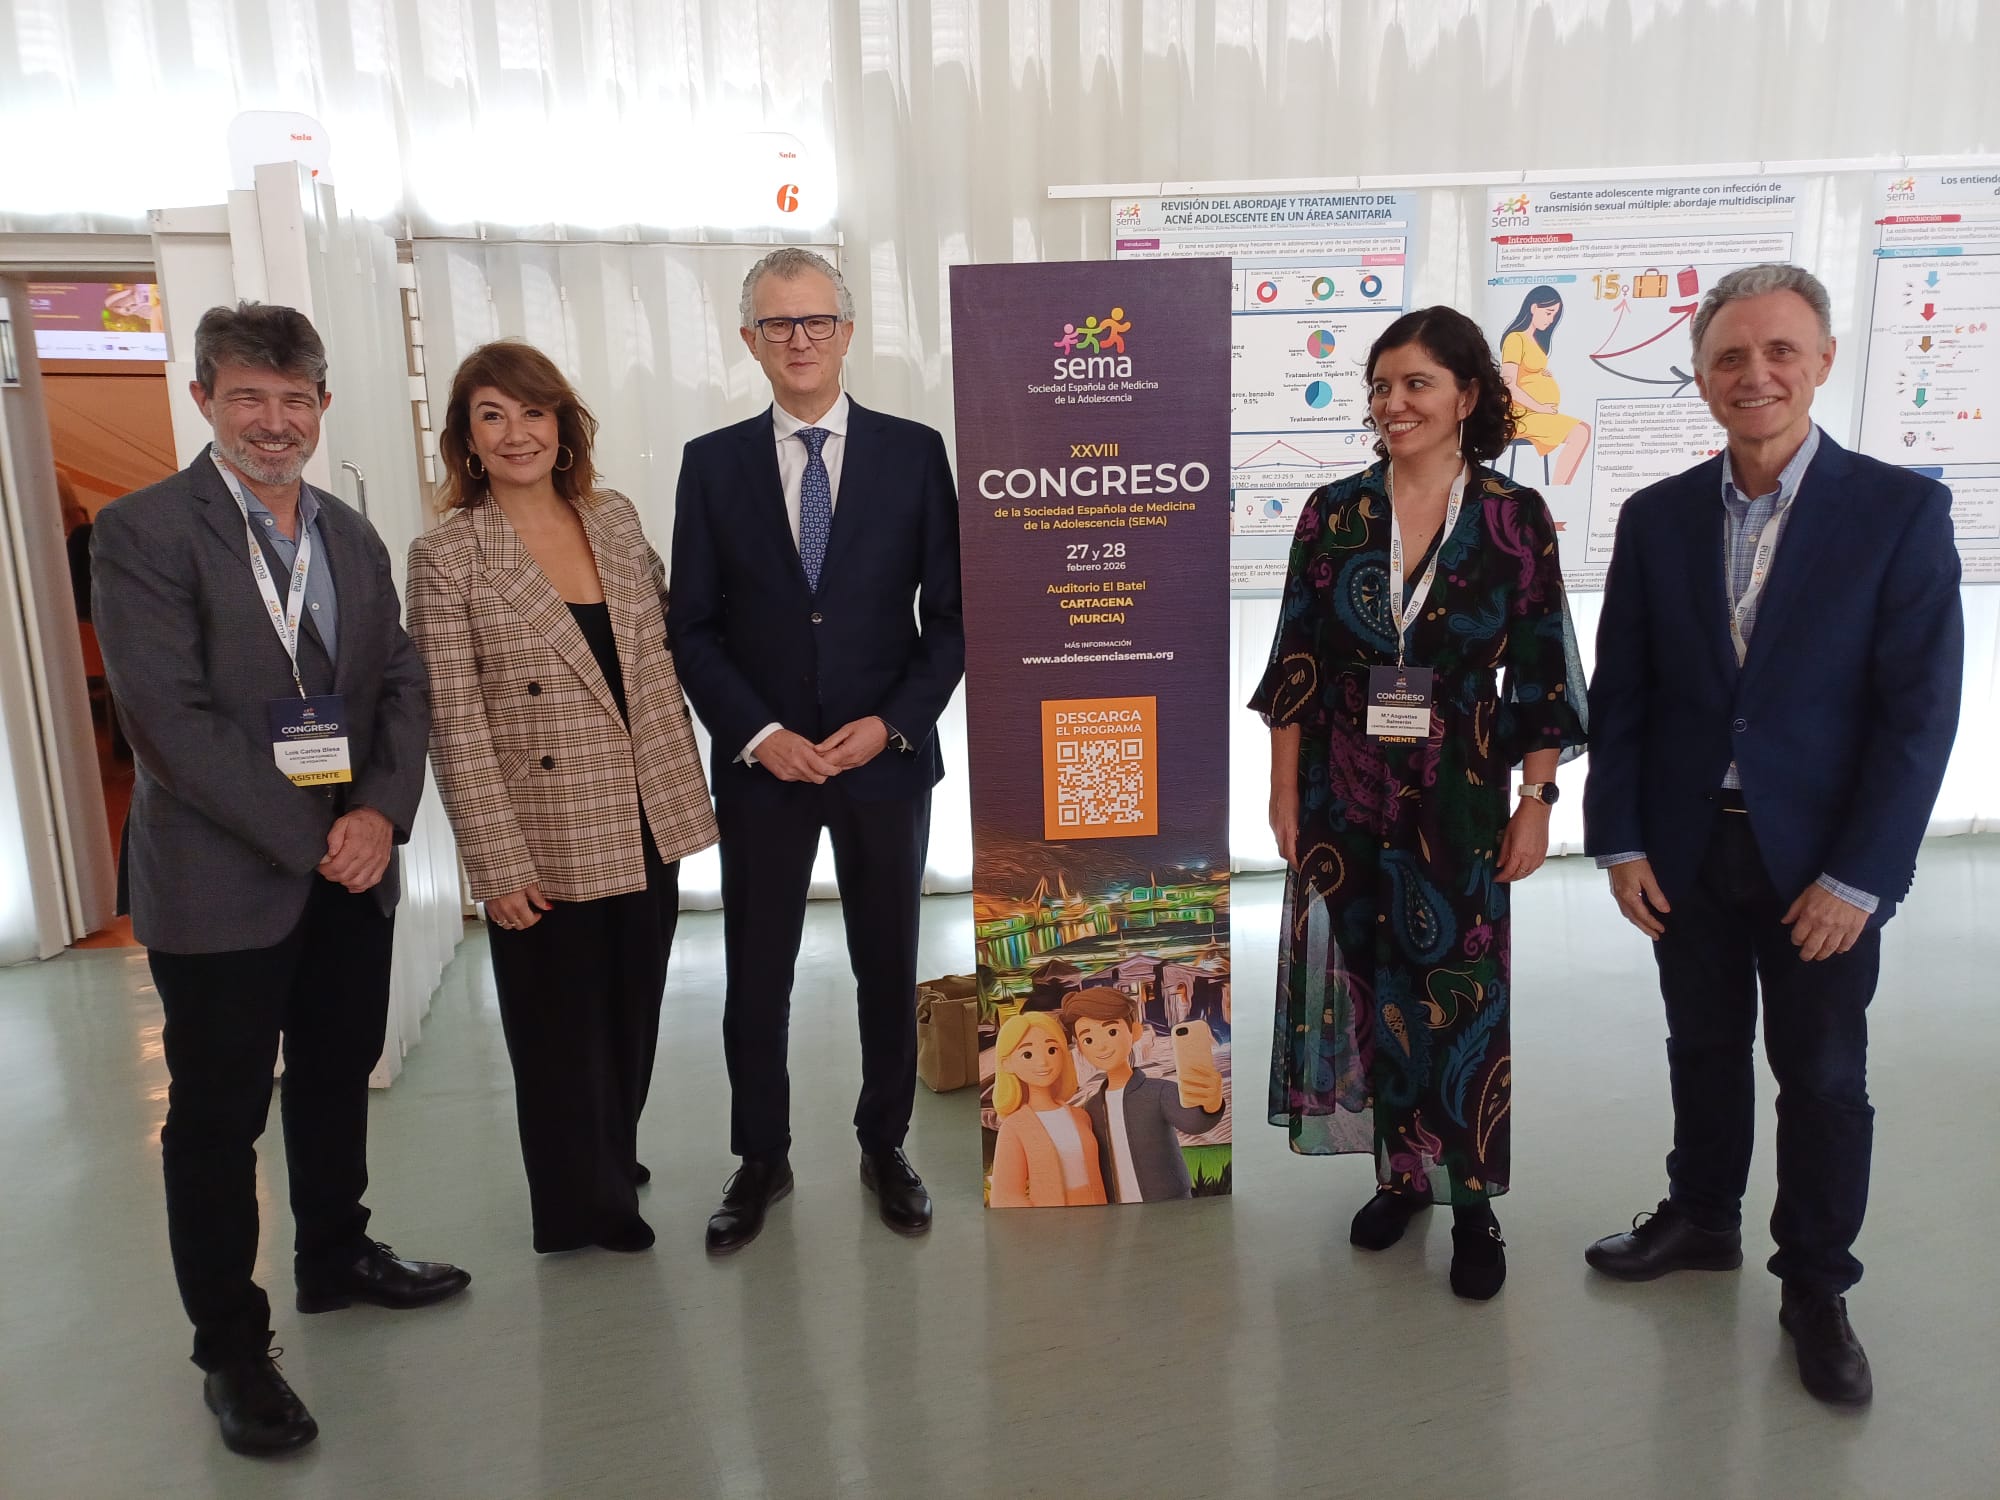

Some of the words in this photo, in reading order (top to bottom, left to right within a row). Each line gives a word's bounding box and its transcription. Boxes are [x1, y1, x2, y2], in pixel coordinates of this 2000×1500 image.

[1941, 175, 1958, 184] Los
[777, 183, 799, 213] 6
[1549, 190, 1593, 200] Gestante
[1595, 188, 1653, 198] adolescente
[1655, 186, 1700, 198] migrante
[1702, 186, 1720, 194] con
[1722, 183, 1767, 193] infección
[1769, 182, 1781, 191] de
[1886, 192, 1915, 202] sema
[1161, 198, 1209, 211] REVISIÓN
[1211, 200, 1230, 210] DEL
[1233, 198, 1287, 210] ABORDAJE
[1288, 198, 1297, 208] Y
[1298, 196, 1374, 207] TRATAMIENTO
[1376, 195, 1396, 205] DEL
[1534, 201, 1593, 213] transmisión
[1594, 200, 1626, 211] sexual
[1628, 198, 1671, 210] múltiple:
[1673, 196, 1717, 209] abordaje
[1719, 194, 1795, 207] multidisciplinar
[1116, 217, 1141, 226] sema
[1164, 212, 1192, 225] ACNÉ
[1195, 212, 1268, 224] ADOLESCENTE
[1271, 212, 1285, 222] EN
[1287, 211, 1304, 222] UN
[1306, 208, 1334, 221] ÁREA
[1336, 208, 1392, 220] SANITARIA
[1491, 216, 1530, 228] sema
[1508, 234, 1559, 244] Introducción
[1592, 273, 1621, 301] 15
[1053, 355, 1132, 380] sema
[1027, 383, 1066, 394] Sociedad
[1068, 381, 1106, 395] Española
[1108, 381, 1119, 391] de
[1121, 380, 1159, 390] Medicina
[1055, 395, 1066, 405] de
[1068, 394, 1076, 404] la
[1077, 393, 1132, 404] Adolescencia
[1070, 443, 1119, 458] XXVIII
[978, 461, 1211, 500] CONGRESO
[994, 507, 1009, 518] de
[1011, 507, 1021, 517] la
[1023, 504, 1074, 517] Sociedad
[1077, 503, 1126, 517] Española
[1129, 502, 1144, 513] de
[1146, 501, 1196, 512] Medicina
[1023, 519, 1038, 530] de
[1040, 519, 1051, 530] la
[1053, 517, 1126, 529] Adolescencia
[1128, 515, 1167, 528] (SEMA)
[1066, 544, 1089, 560] 27
[1091, 549, 1101, 561] y
[1102, 542, 1126, 559] 28
[1756, 545, 1769, 570] sema
[253, 554, 267, 580] sema
[1066, 561, 1101, 572] febrero
[1103, 561, 1126, 571] 2026
[293, 572, 304, 593] sema
[1046, 582, 1100, 594] Auditorio
[1102, 581, 1114, 593] El
[1116, 580, 1146, 592] Batel
[1060, 596, 1133, 609] CARTAGENA
[1069, 612, 1125, 626] (MURCIA)
[1064, 639, 1080, 649] MÁS
[1081, 638, 1132, 648] INFORMACIÓN
[1022, 649, 1174, 665] www.adolescenciasema.org
[1376, 692, 1425, 702] CONGRESO
[1055, 709, 1142, 725] DESCARGA
[281, 723, 339, 734] CONGRESO
[1055, 726, 1071, 736] EL
[1073, 723, 1143, 735] PROGRAMA
[1378, 735, 1417, 744] PONENTE
[290, 771, 340, 782] ASISTENTE
